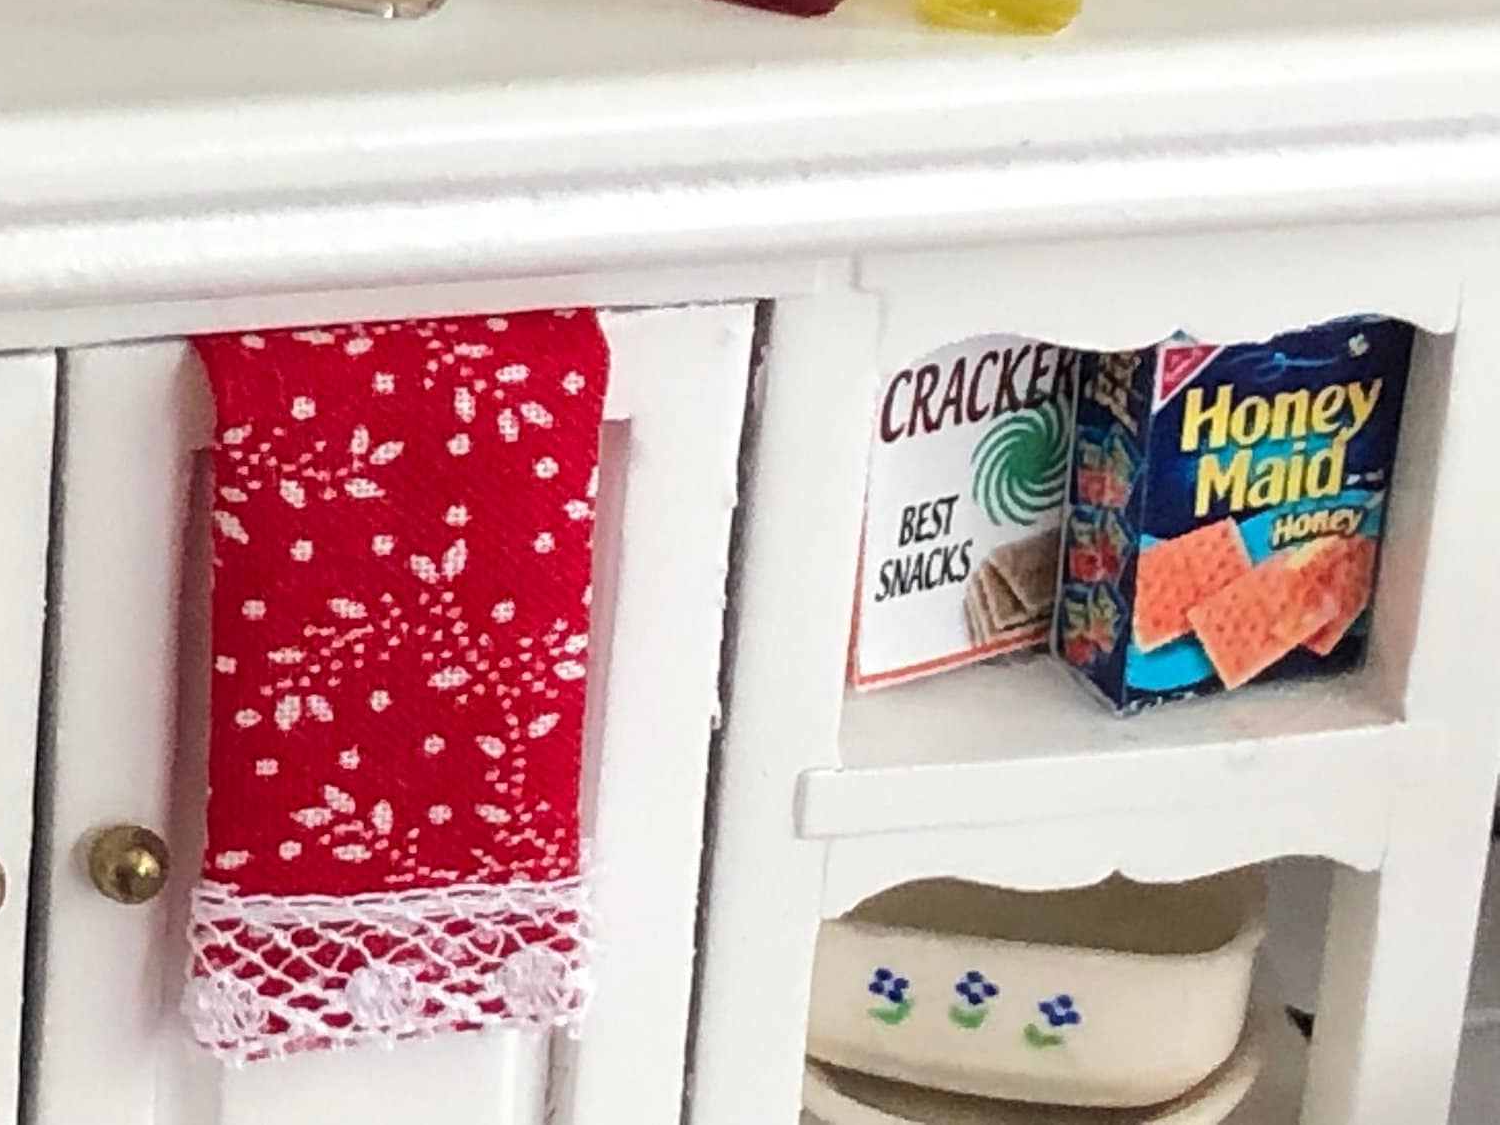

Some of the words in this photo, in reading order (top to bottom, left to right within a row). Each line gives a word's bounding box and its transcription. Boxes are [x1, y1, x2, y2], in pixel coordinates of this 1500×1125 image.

[1180, 377, 1383, 454] Honey
[1194, 430, 1348, 517] Maid
[898, 493, 960, 548] BEST
[1270, 506, 1364, 547] Honey
[874, 538, 974, 603] SNACKS
